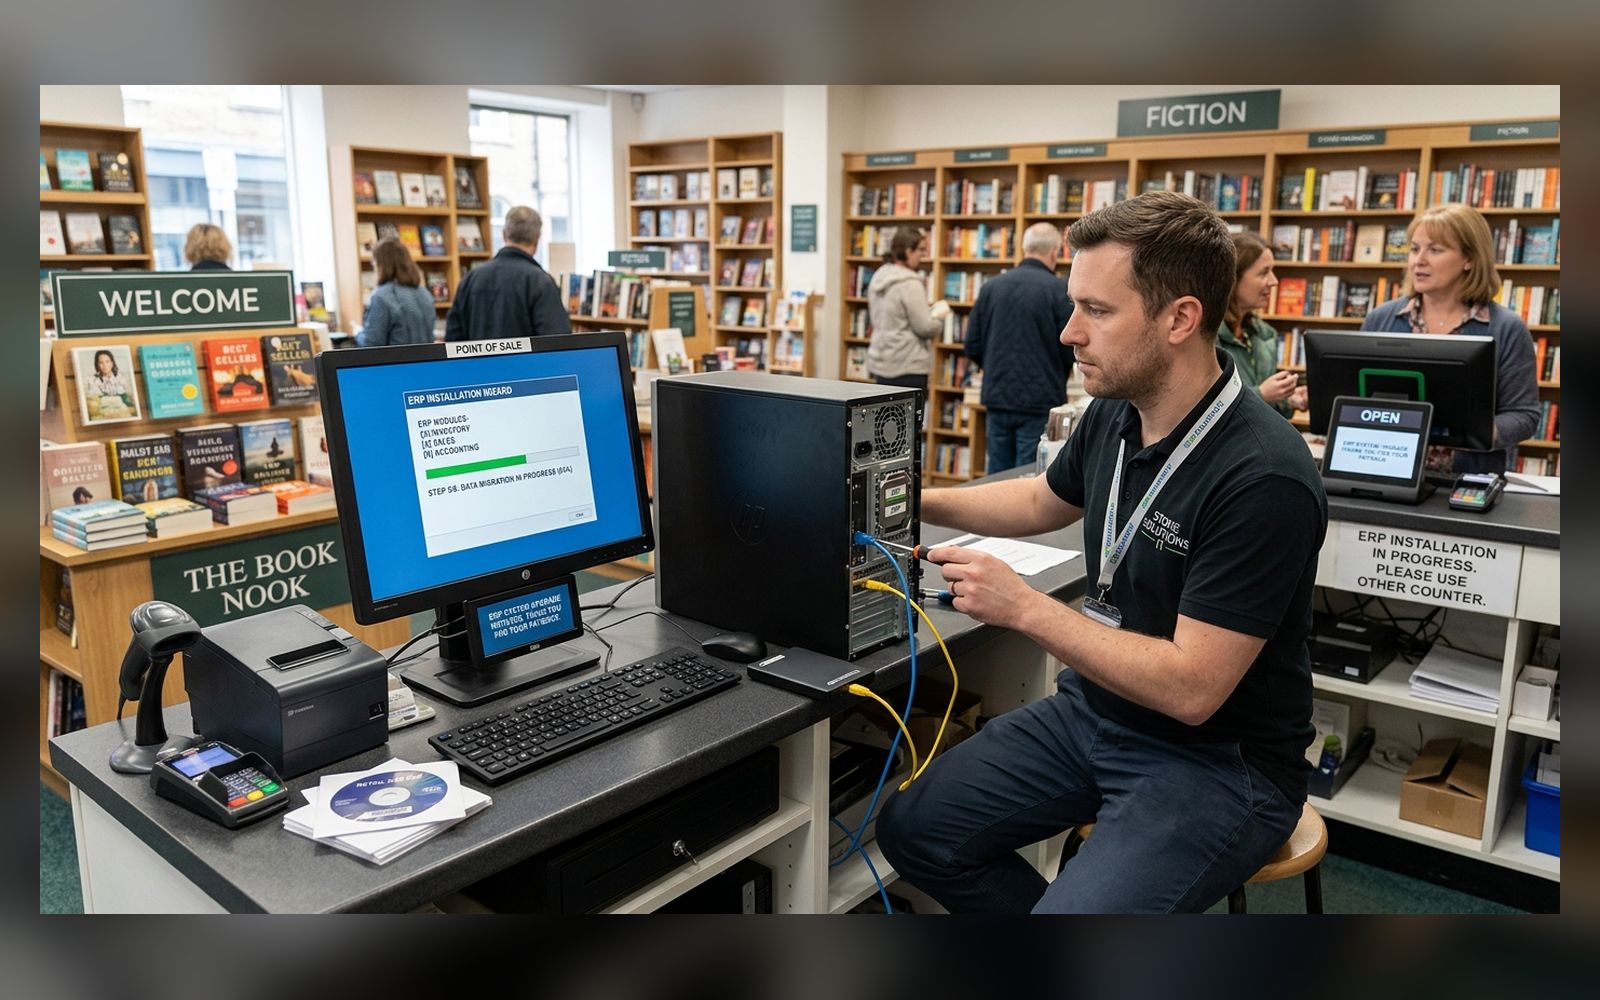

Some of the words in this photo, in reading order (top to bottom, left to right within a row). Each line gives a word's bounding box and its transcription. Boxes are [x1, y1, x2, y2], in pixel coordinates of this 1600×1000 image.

[1146, 100, 1247, 128] FICTION
[98, 287, 260, 317] WELCOME
[456, 343, 482, 354] POINT
[485, 342, 498, 352] OF
[499, 340, 522, 351] SALE
[408, 396, 425, 405] ERP
[426, 389, 482, 403] INSTALLATION
[417, 418, 432, 428] ERP
[1360, 409, 1401, 424] OPEN
[427, 487, 447, 497] STEP
[1357, 530, 1387, 544] ERP
[1390, 534, 1497, 560] INSTALLATION
[183, 559, 248, 593] THE
[254, 541, 339, 579] BOOK
[1372, 547, 1387, 560] IN
[1390, 550, 1477, 573] PROGRESS.
[1376, 563, 1433, 583] PLEASE
[1437, 573, 1467, 587] USE
[220, 574, 311, 615] NOOK
[1357, 576, 1406, 594] OTHER
[1410, 584, 1487, 606] COUNTER.
